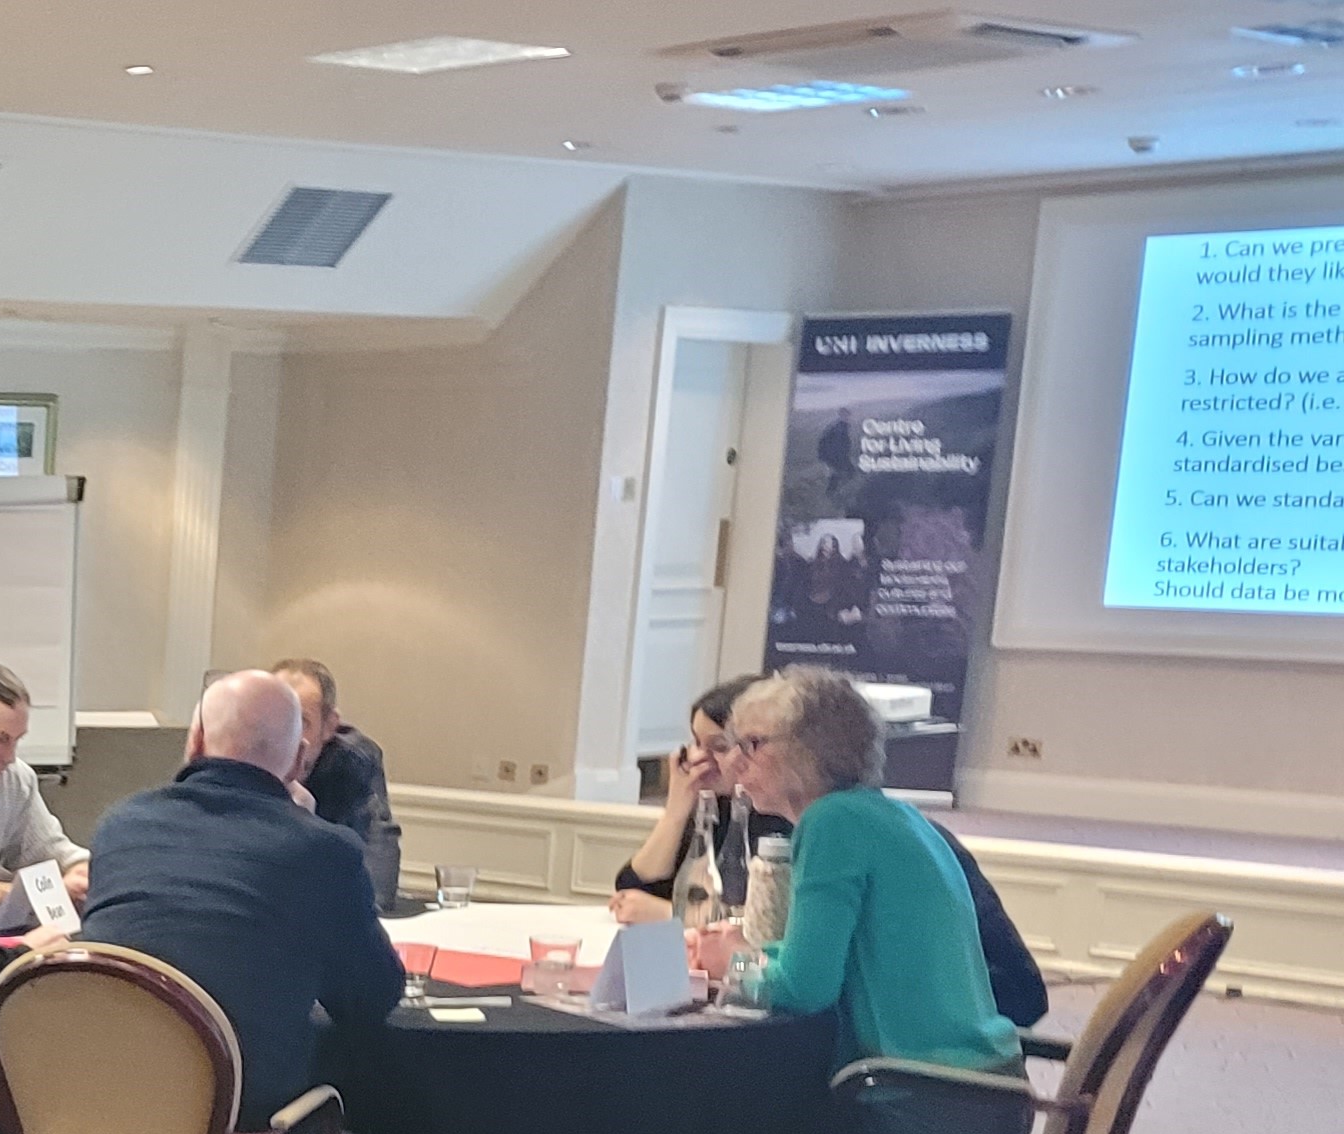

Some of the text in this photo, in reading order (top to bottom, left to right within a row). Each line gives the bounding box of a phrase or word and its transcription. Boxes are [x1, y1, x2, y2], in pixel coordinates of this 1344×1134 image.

[1199, 241, 1218, 259] 1.
[1225, 240, 1265, 257] Can
[1272, 240, 1303, 255] we
[1196, 264, 1261, 285] would
[1269, 263, 1316, 284] they
[1191, 299, 1341, 322] 2. What is the
[865, 331, 991, 353] INVERNESS
[1188, 325, 1344, 350] sampling meth
[1183, 368, 1202, 386] 3.
[1210, 367, 1257, 386] How
[1263, 366, 1291, 385] do
[1298, 370, 1330, 384] we
[1180, 391, 1341, 414] restricted? (i.e.
[862, 418, 925, 436] Centre
[888, 436, 942, 457] Living
[1175, 430, 1195, 448] 4.
[1201, 430, 1261, 448] Given
[1269, 429, 1303, 447] the
[858, 453, 981, 475] Sustainability
[1173, 455, 1309, 473] standardised
[1164, 489, 1344, 508] 5. Can we standa
[1160, 531, 1177, 548] 6.
[1185, 531, 1241, 549] What
[1247, 536, 1282, 550] are
[1156, 554, 1301, 576] stakeholders?
[1153, 579, 1224, 599] Should
[1230, 582, 1276, 600] data
[1283, 584, 1310, 601] be
